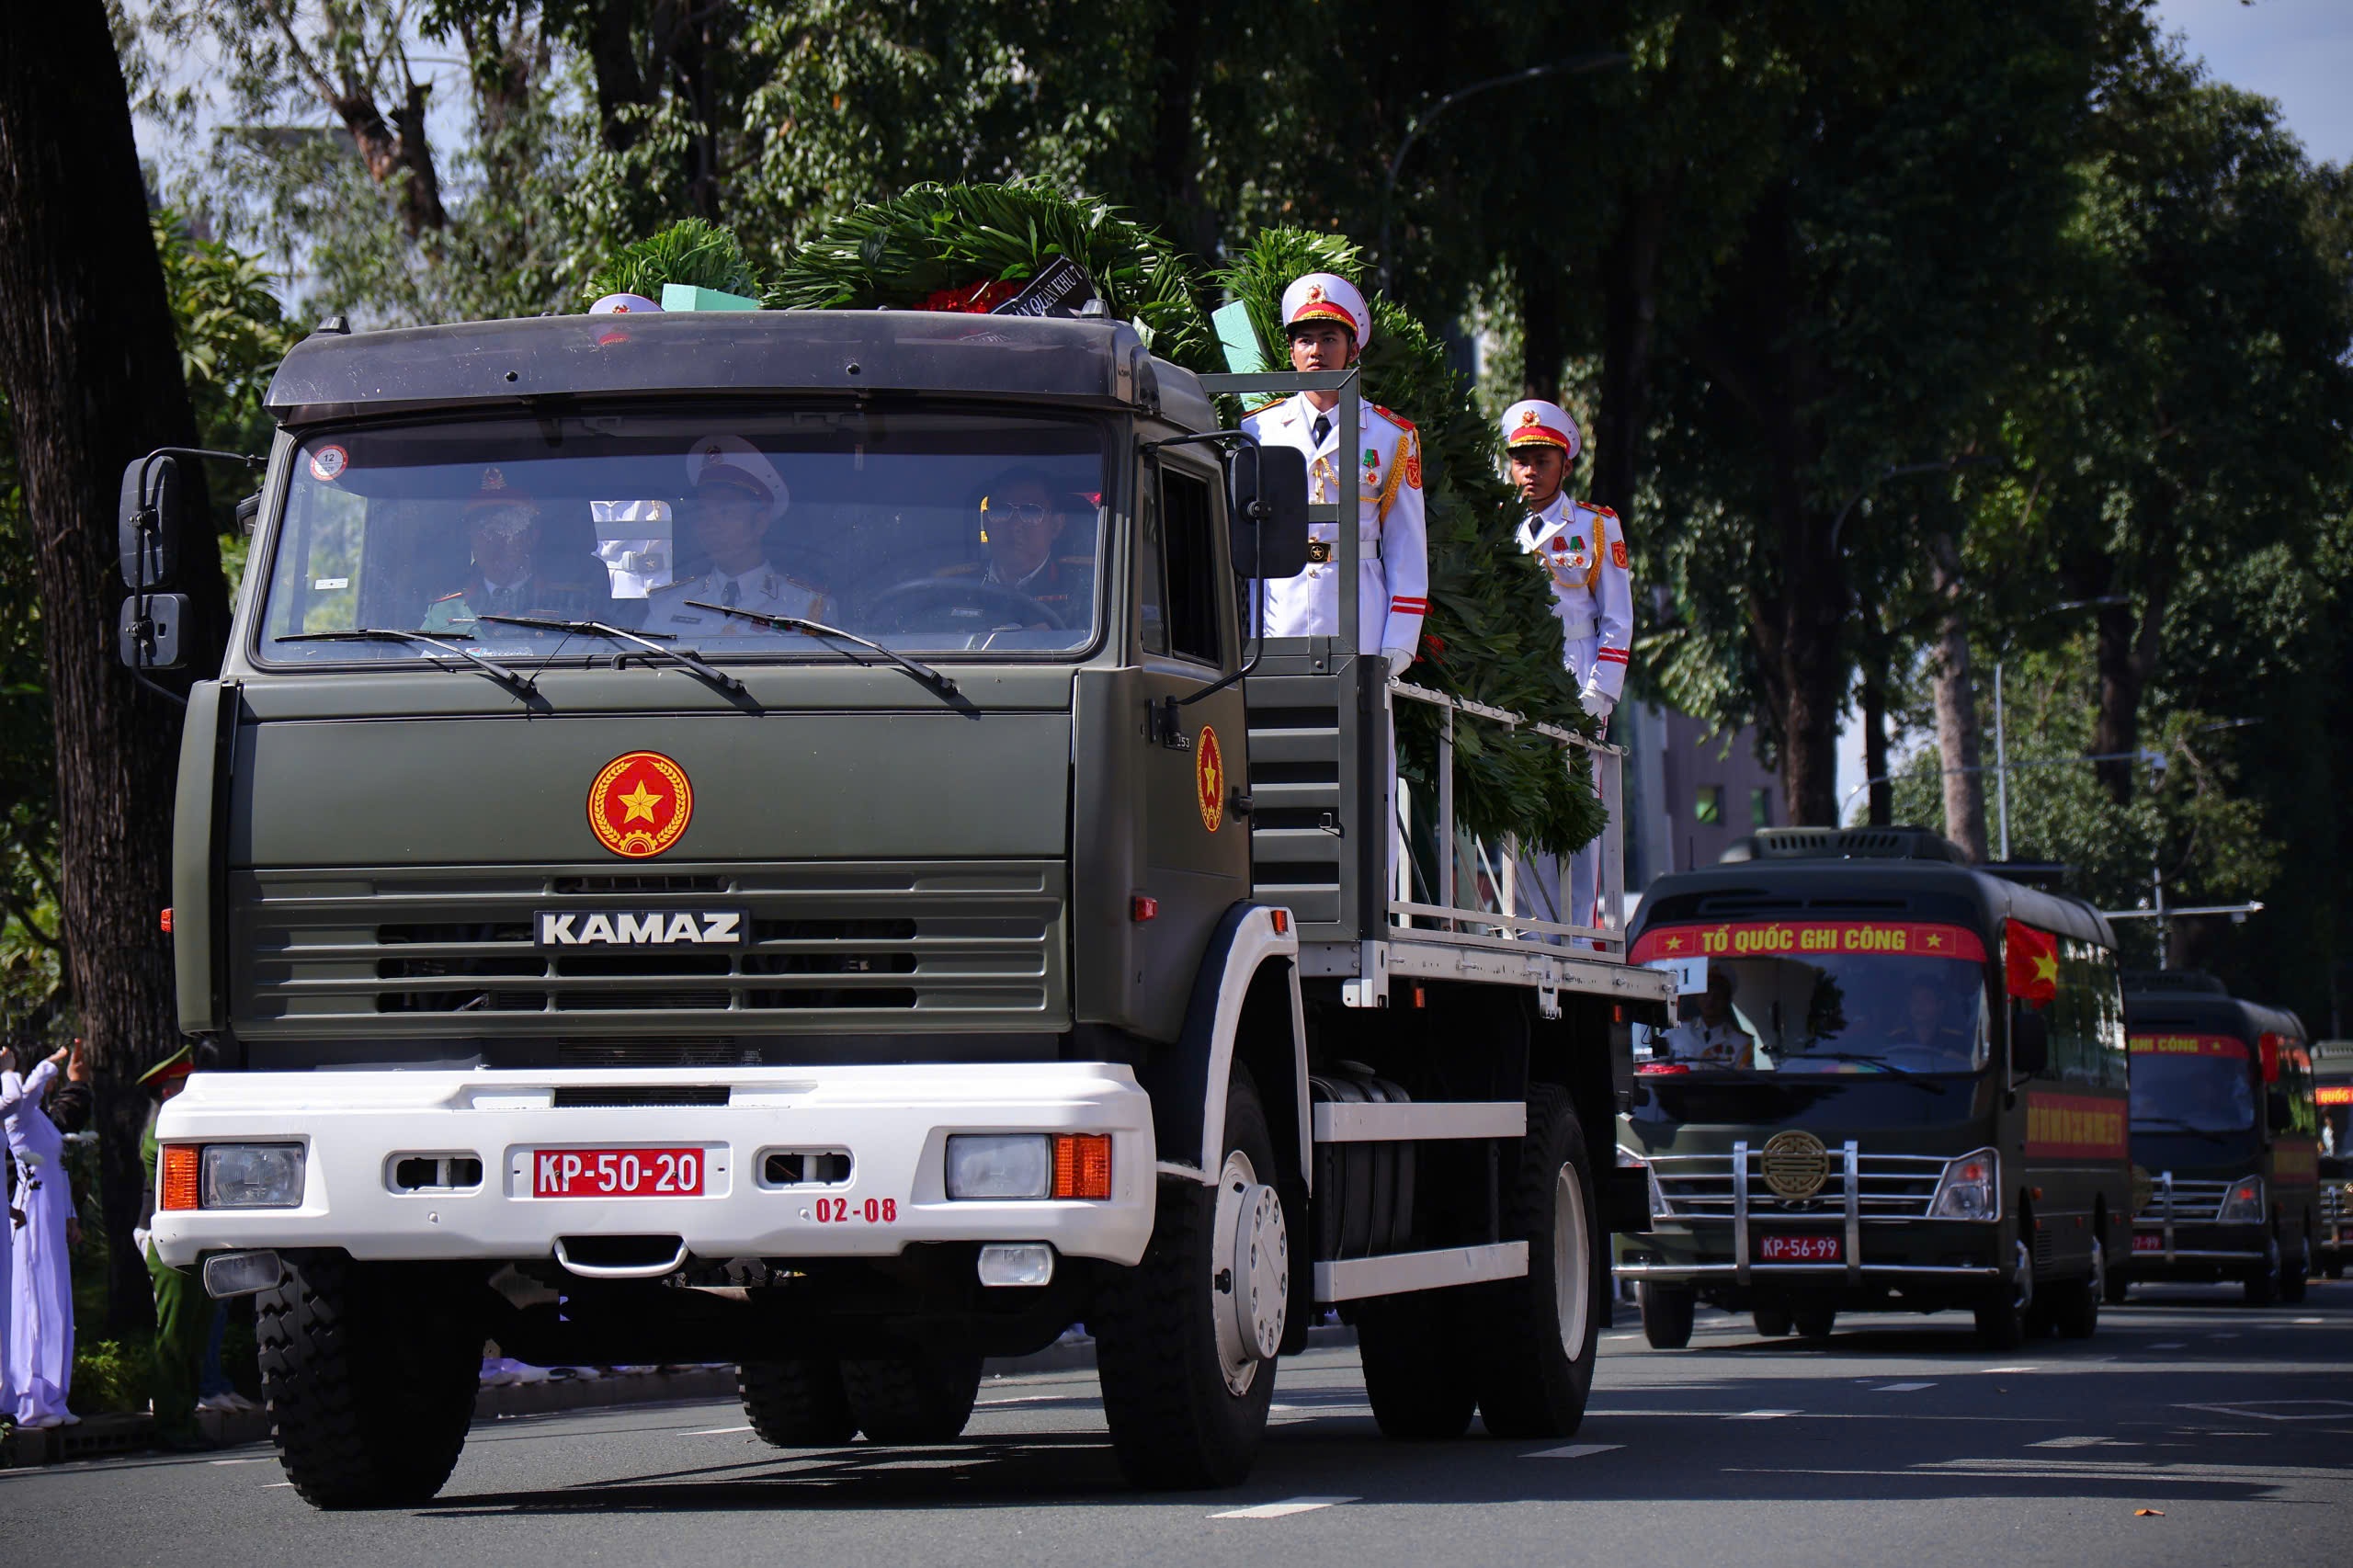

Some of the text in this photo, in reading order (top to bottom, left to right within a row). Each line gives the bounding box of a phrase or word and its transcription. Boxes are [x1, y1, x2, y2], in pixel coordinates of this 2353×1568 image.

[1051, 269, 1076, 295] KHU
[1069, 264, 1083, 279] 7
[324, 453, 335, 462] 12
[542, 913, 740, 945] KAMAZ
[1734, 923, 1793, 953] QUỐC
[1801, 929, 1837, 949] GHI
[1845, 926, 1906, 950] CÔNG
[2157, 1034, 2200, 1053] CÔNG
[539, 1153, 698, 1193] KP-50-20
[815, 1198, 897, 1223] 02-08
[1763, 1239, 1837, 1257] KP-56-99
